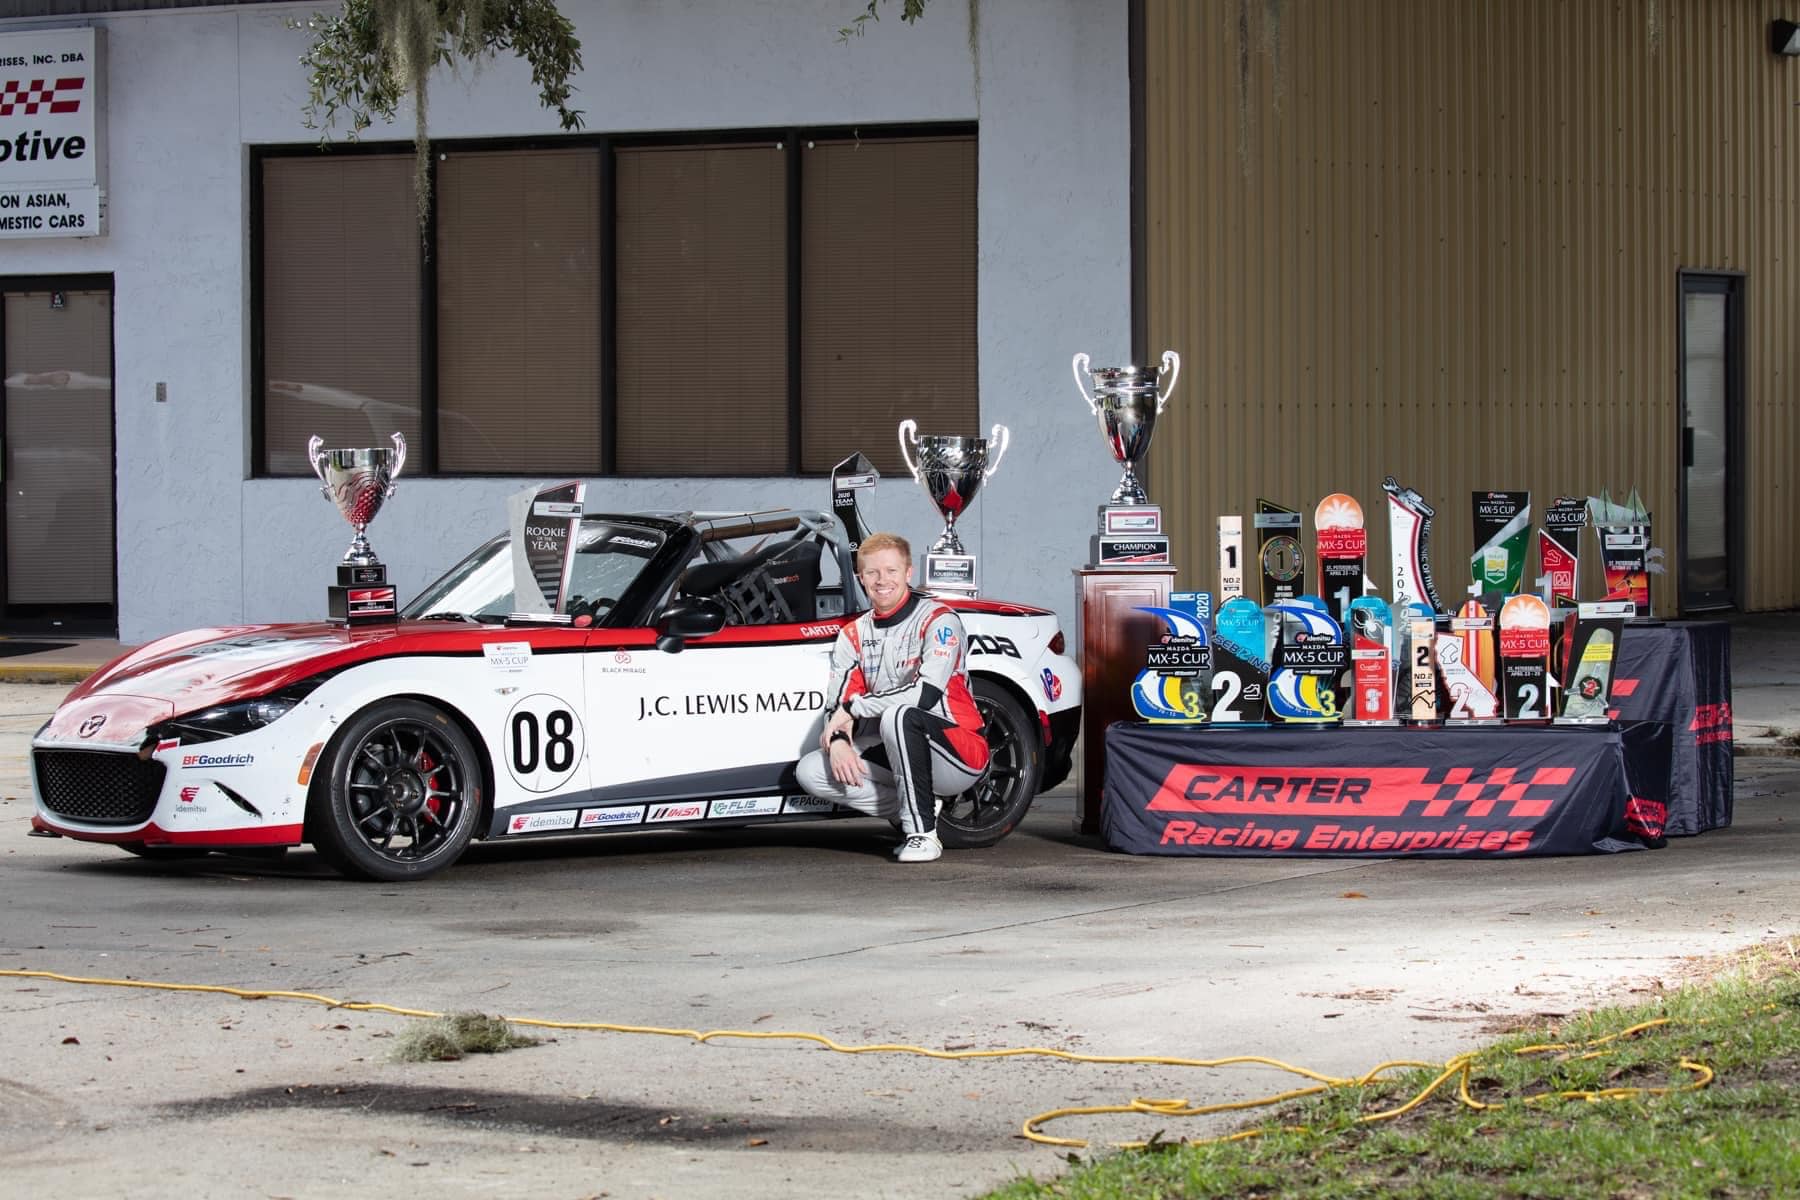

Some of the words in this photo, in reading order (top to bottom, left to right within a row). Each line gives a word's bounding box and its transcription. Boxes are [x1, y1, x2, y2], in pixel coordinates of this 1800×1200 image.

[33, 54, 56, 65] INC.
[61, 53, 84, 63] DBA
[1, 195, 19, 208] ON
[26, 193, 70, 208] ASIAN,
[49, 214, 85, 228] CARS
[1480, 505, 1497, 514] MX-5
[1499, 505, 1515, 514] CUP
[1546, 513, 1566, 523] MX-5
[1567, 513, 1585, 522] CUP
[526, 526, 566, 537] ROOKIE
[532, 541, 557, 551] YEAR
[1113, 543, 1156, 551] CHAMPION
[1320, 540, 1344, 550] MX-5
[1345, 540, 1365, 549] CUP
[1225, 546, 1236, 568] 1
[1276, 551, 1284, 570] 1
[1536, 571, 1552, 608] 1
[1197, 593, 1209, 619] 2020
[1334, 586, 1350, 623] 1
[800, 624, 840, 638] CARTER
[1501, 640, 1525, 649] MX-5
[1527, 640, 1549, 649] CUP
[490, 656, 510, 665] MX-5
[512, 656, 528, 665] CUP
[1148, 653, 1179, 664] MX-5
[1182, 653, 1209, 664] CUP
[1283, 652, 1315, 663] MX-5
[1318, 652, 1344, 663] CUP
[1416, 646, 1429, 667] 2
[1585, 679, 1597, 696] 2
[1211, 671, 1242, 721] 2
[1320, 690, 1336, 716] 3
[1450, 683, 1469, 718] 2
[1518, 684, 1540, 719] 2
[638, 696, 677, 720] J.C.
[686, 693, 748, 715] LEWIS
[756, 691, 825, 713] MAZD
[1184, 692, 1199, 718] 3
[512, 709, 574, 774] 08
[182, 754, 254, 766] BFGoodrich
[1183, 775, 1372, 804] CARTER
[175, 805, 207, 813] idemitsu
[728, 800, 757, 810] FLIS
[584, 809, 641, 822] BFGoodrich
[667, 807, 701, 818] IMSA
[530, 816, 573, 829] idemitsu
[1160, 819, 1303, 851] Racing
[1308, 824, 1534, 852] Enterprises
